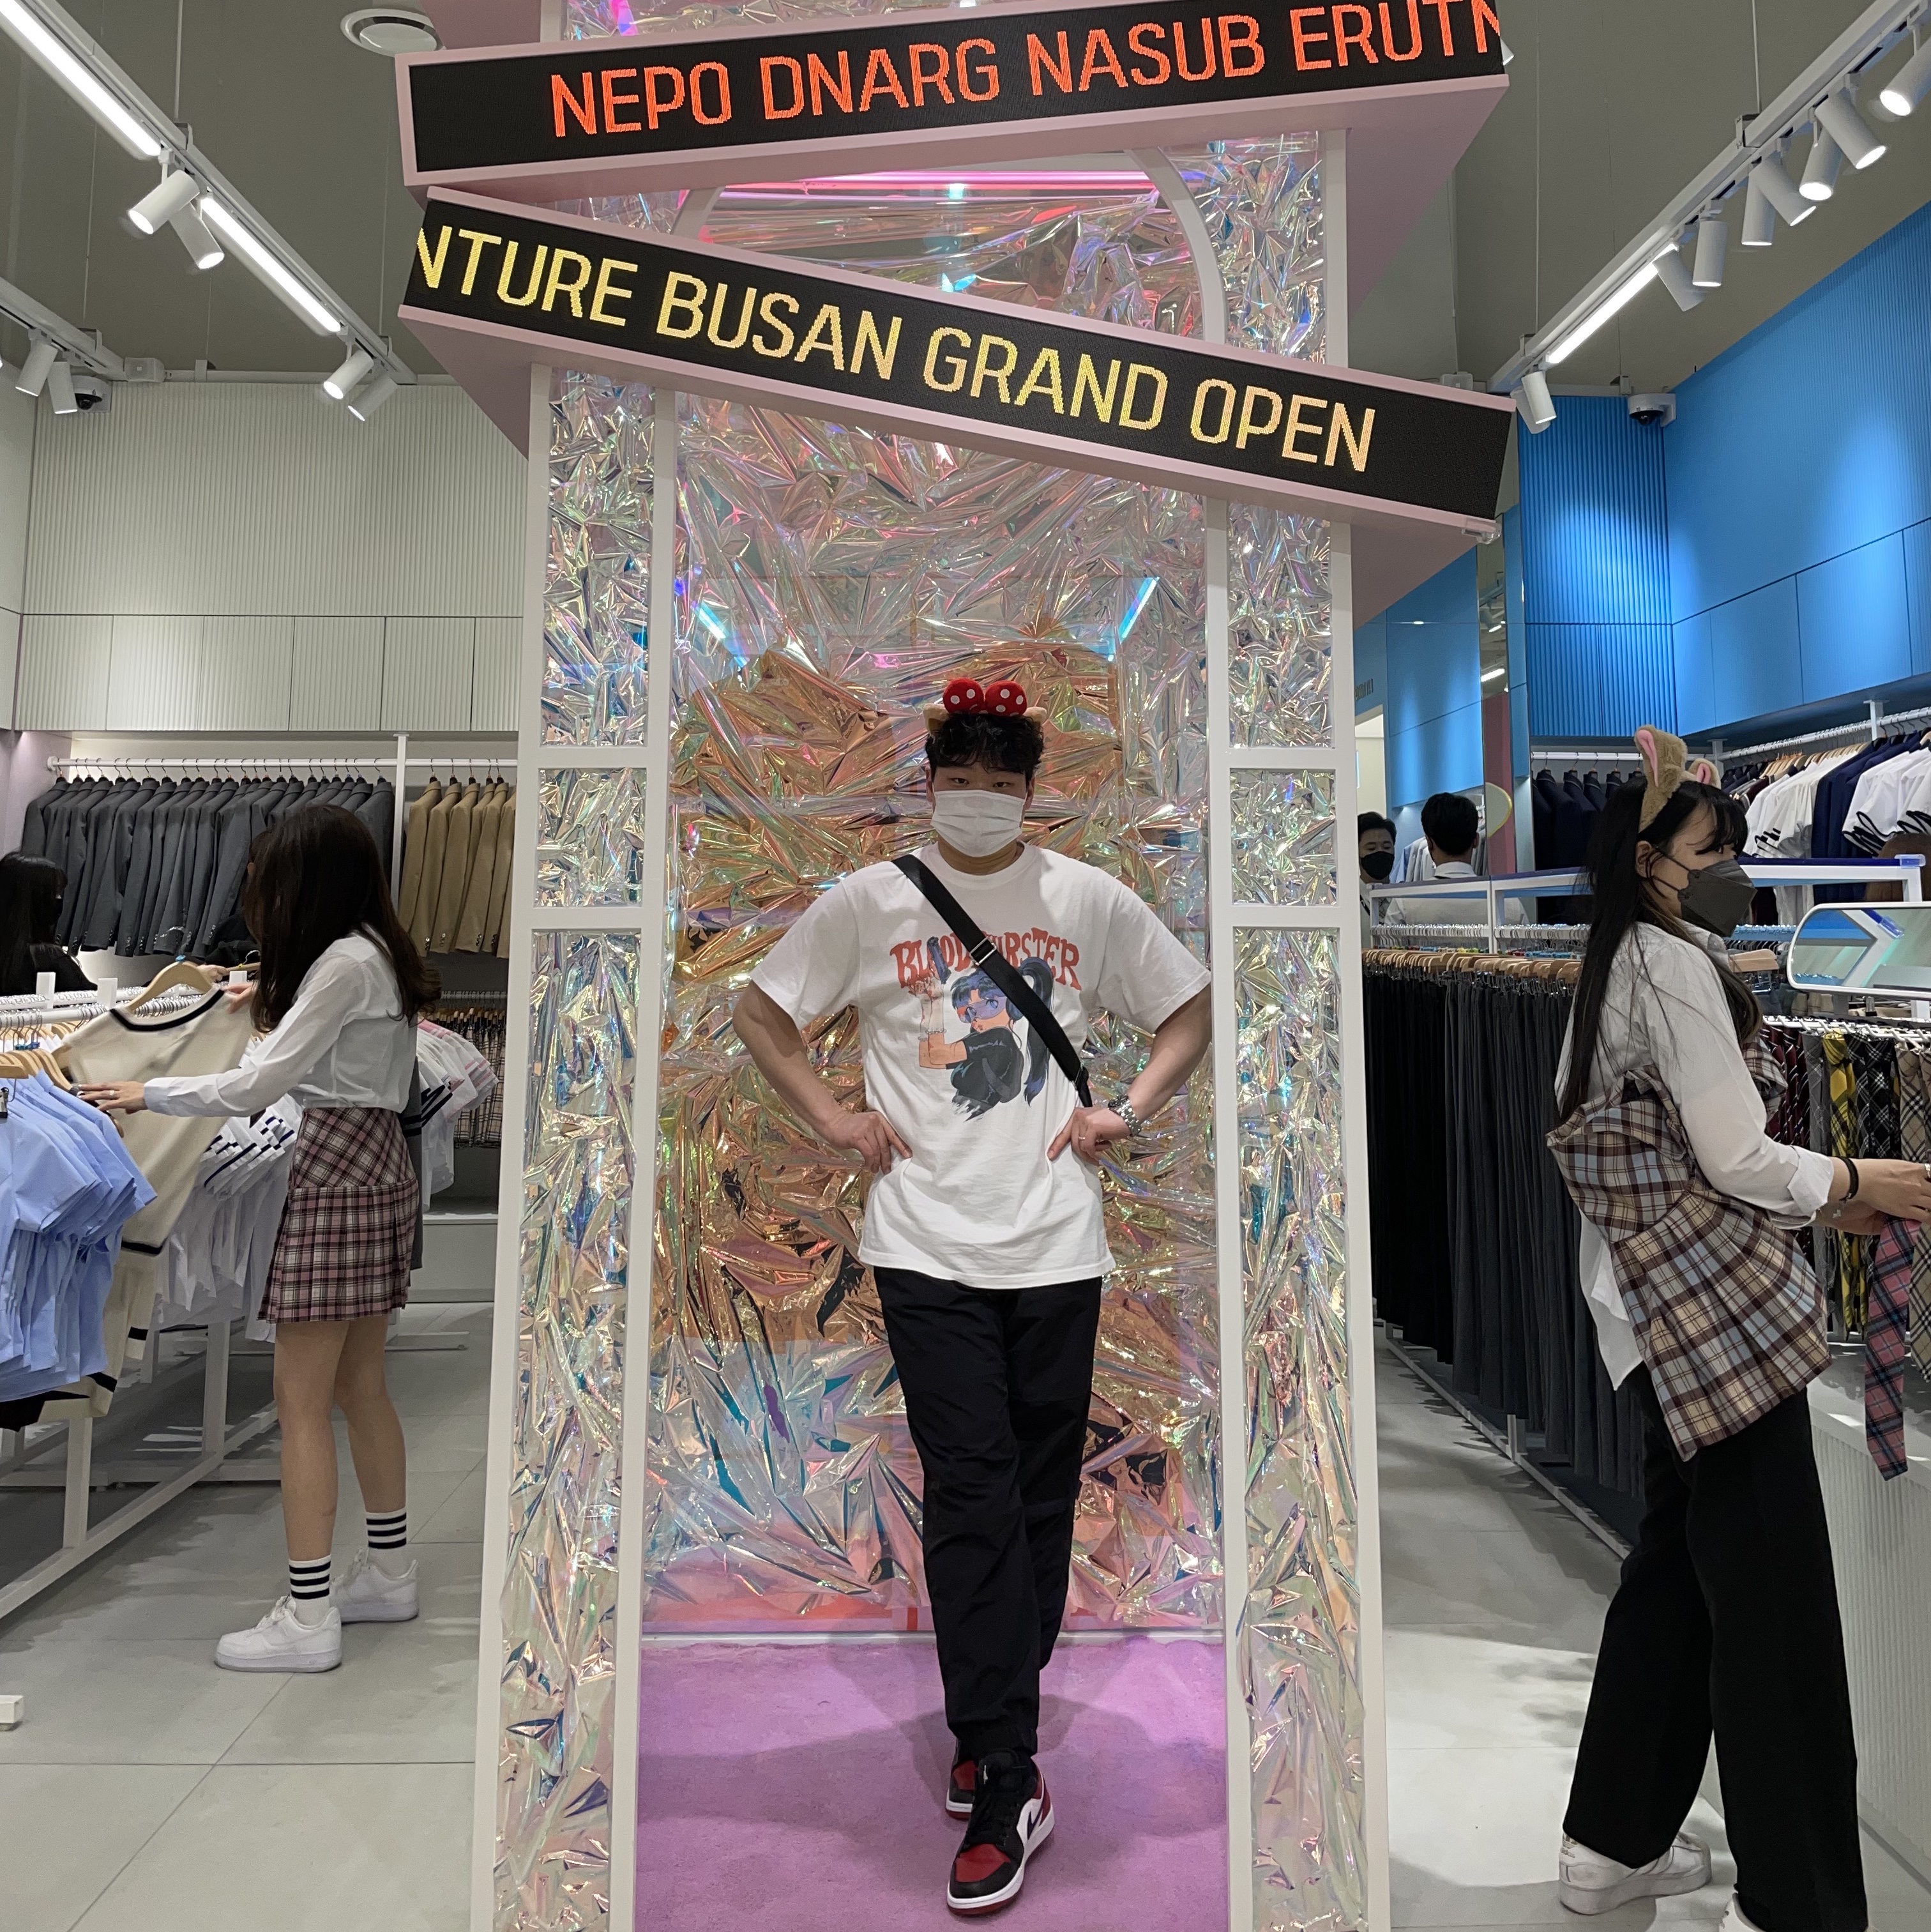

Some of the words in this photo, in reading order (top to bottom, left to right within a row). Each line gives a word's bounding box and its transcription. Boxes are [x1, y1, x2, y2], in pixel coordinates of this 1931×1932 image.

[551, 60, 732, 137] NEPO
[760, 38, 999, 119] DNARG
[1027, 15, 1265, 96] NASUB
[656, 271, 902, 380] BUSAN
[923, 326, 1169, 430] GRAND
[1190, 378, 1375, 472] OPEN
